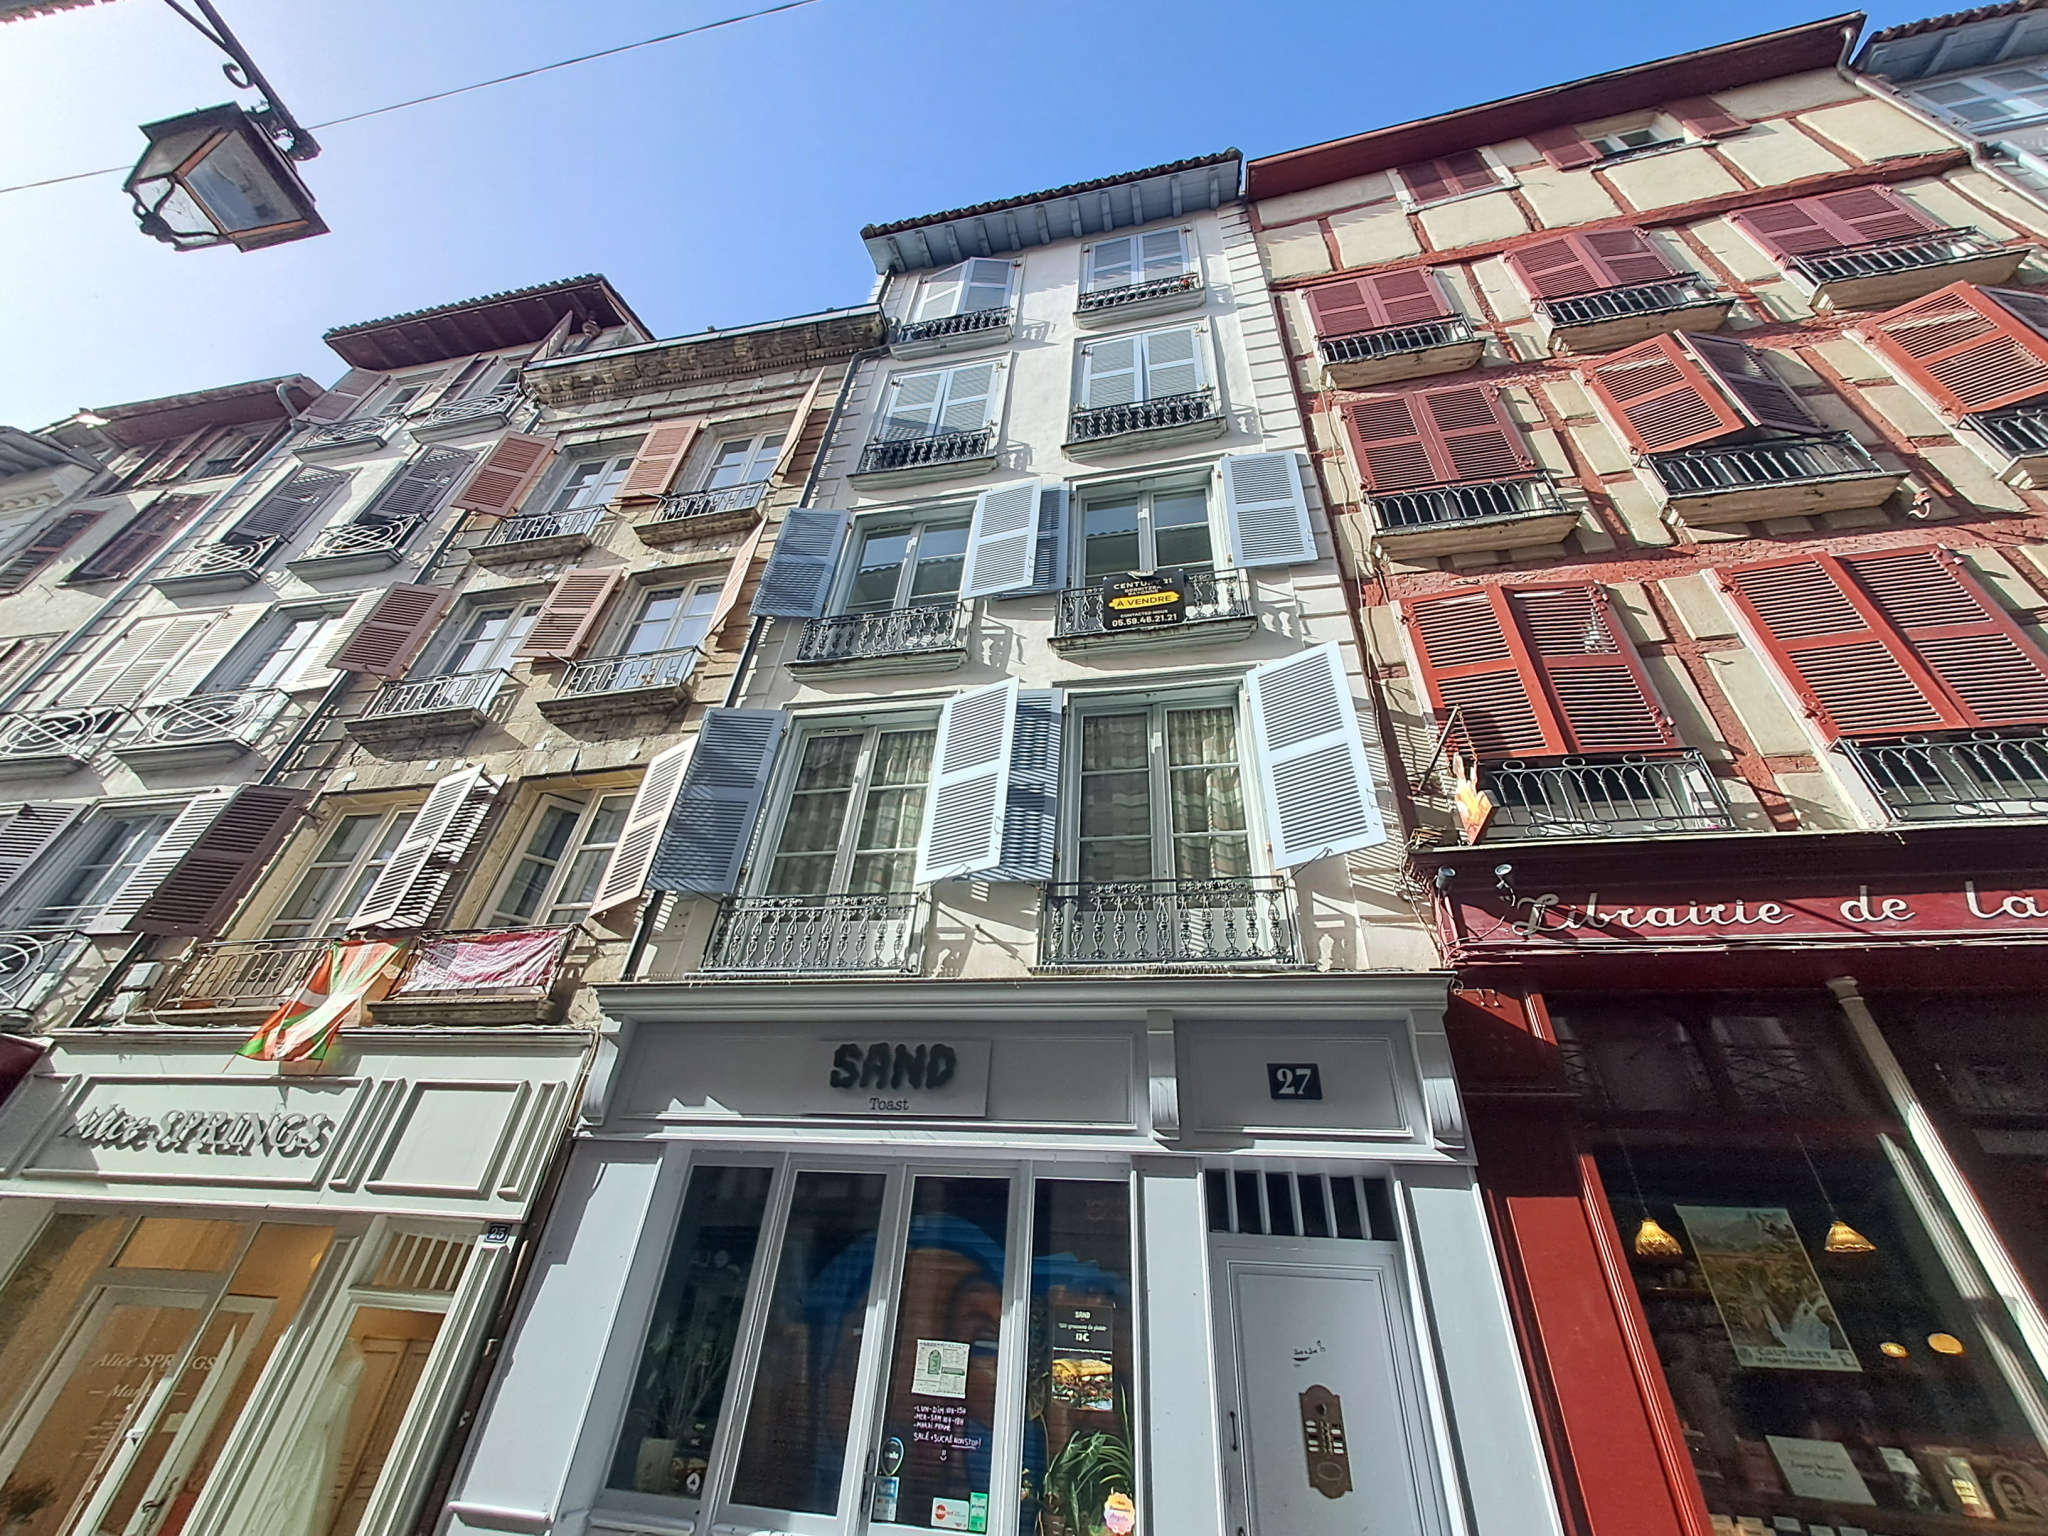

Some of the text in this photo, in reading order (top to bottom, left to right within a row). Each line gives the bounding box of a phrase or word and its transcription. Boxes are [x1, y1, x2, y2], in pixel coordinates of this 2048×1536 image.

[1127, 595, 1171, 605] VENDRE
[1120, 609, 1168, 618] CONTACTEZ-NOUS
[1512, 881, 2048, 936] Librairie de la
[829, 1042, 957, 1090] SAND
[1276, 1068, 1312, 1095] 27
[870, 1097, 910, 1111] Toast
[58, 1103, 329, 1148] Alice SPRINGS
[488, 1226, 506, 1240] 25
[93, 1353, 217, 1370] Alice SPRGS
